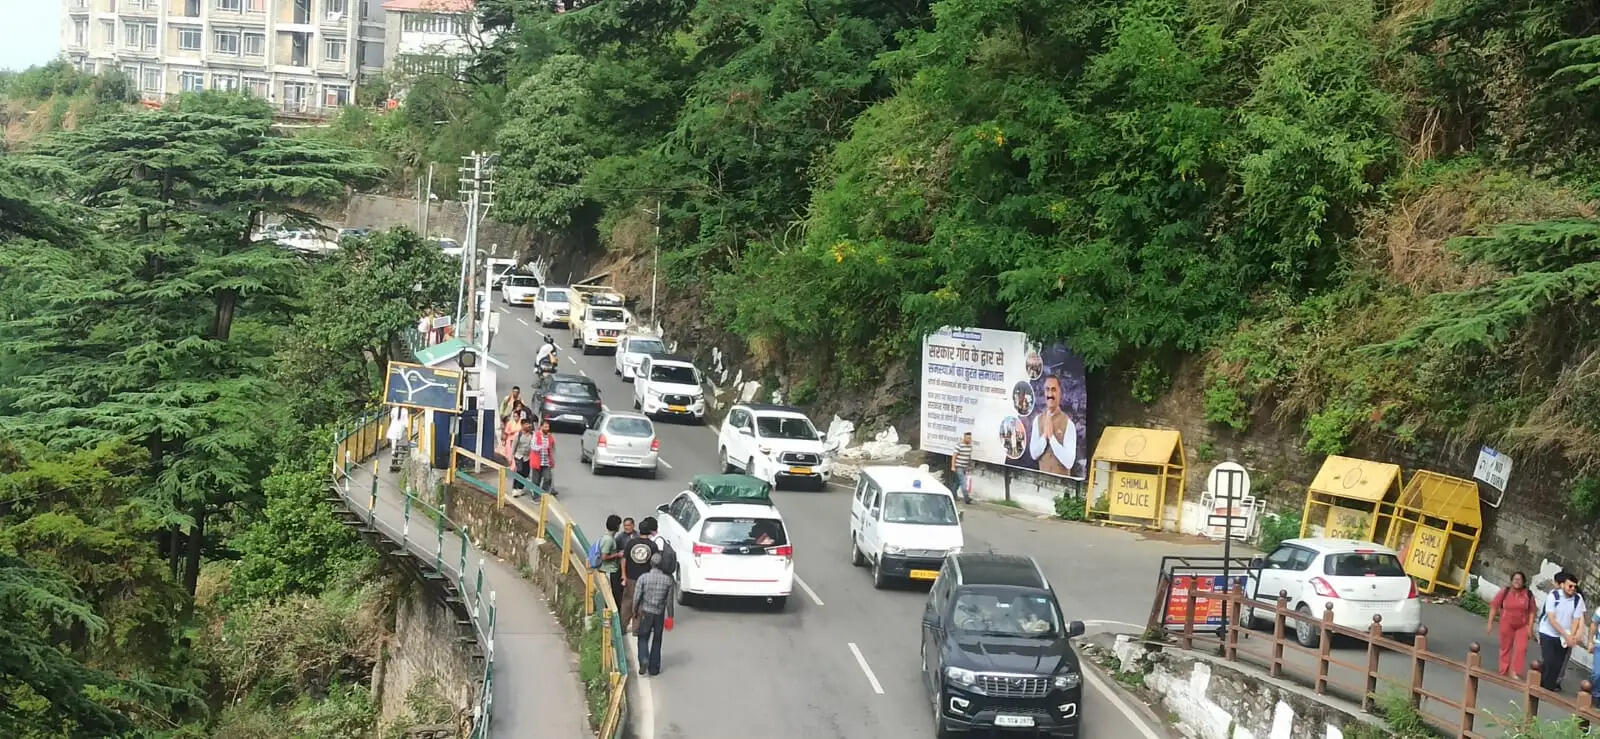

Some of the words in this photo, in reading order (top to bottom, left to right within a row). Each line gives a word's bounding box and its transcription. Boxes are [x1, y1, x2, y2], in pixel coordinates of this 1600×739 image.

[928, 344, 955, 360] सरकार
[971, 345, 979, 362] के
[981, 350, 994, 366] द्वार
[995, 347, 1004, 366] से
[1494, 461, 1504, 473] NO
[1120, 476, 1149, 490] SHIMLA
[1490, 473, 1505, 489] TURN
[1117, 491, 1149, 508] POLICE
[1412, 548, 1438, 569] POLICE
